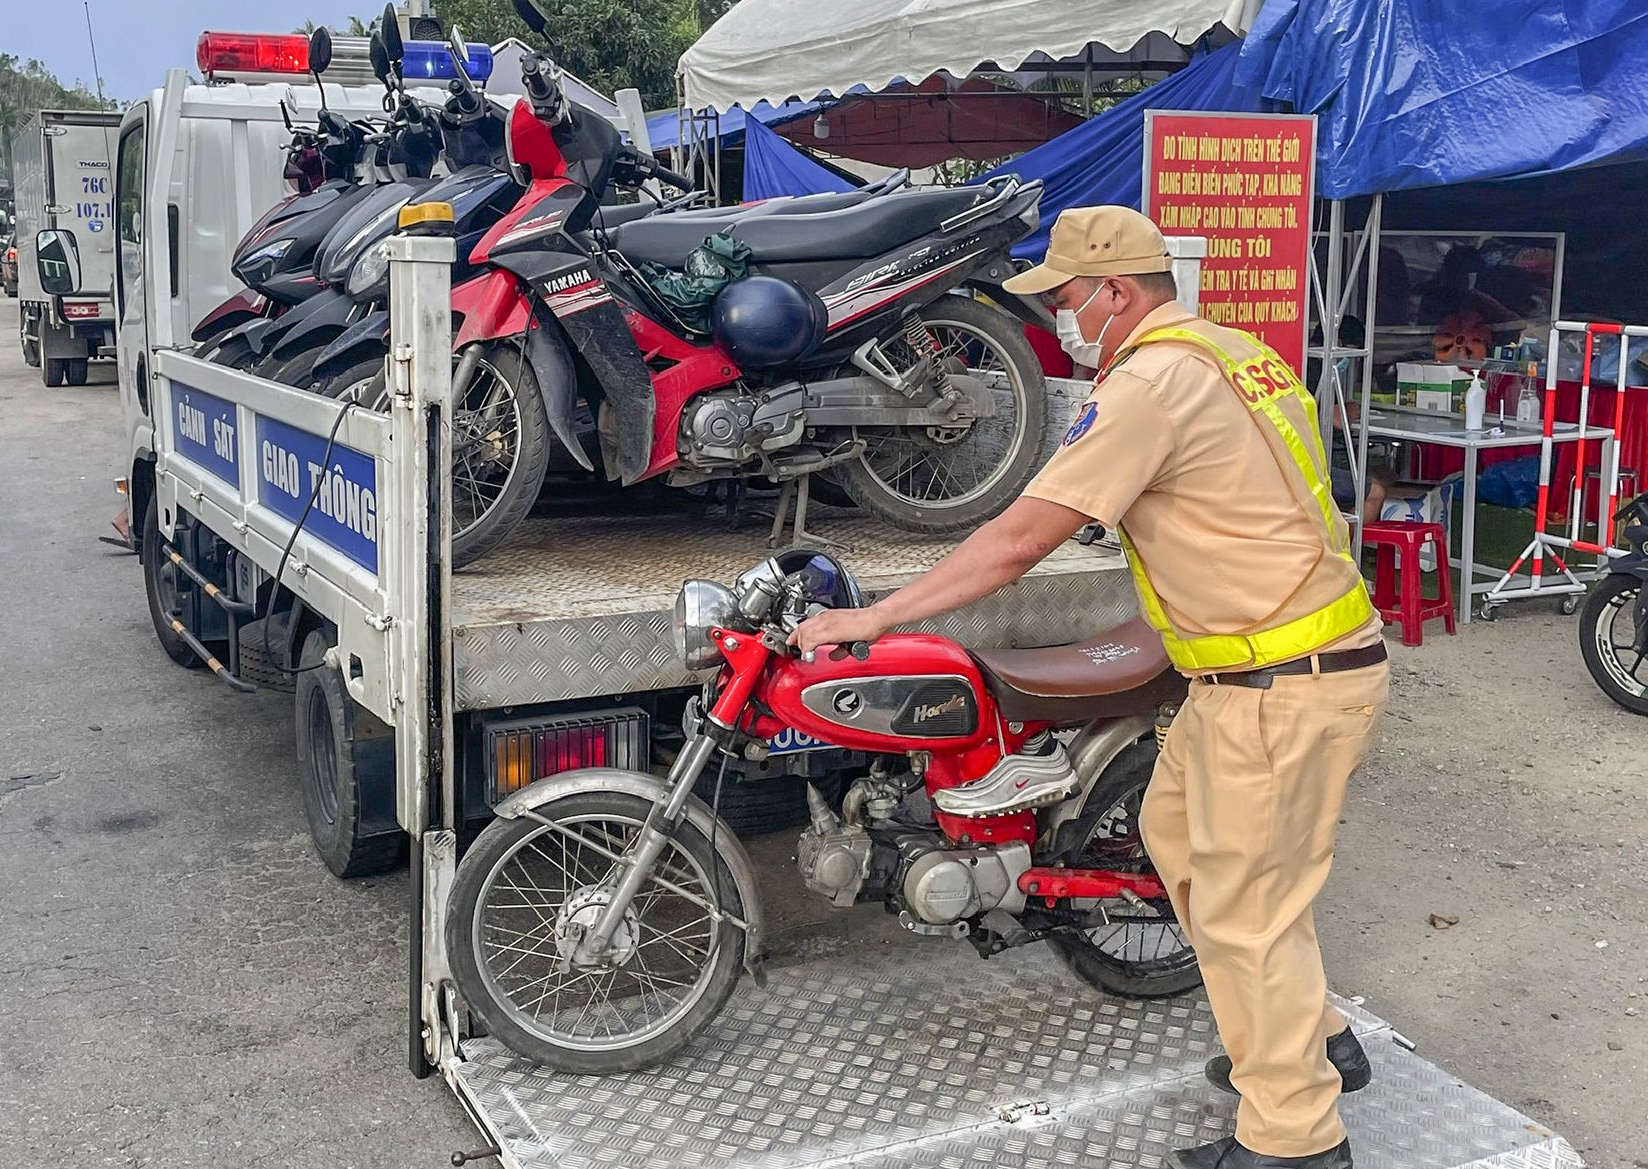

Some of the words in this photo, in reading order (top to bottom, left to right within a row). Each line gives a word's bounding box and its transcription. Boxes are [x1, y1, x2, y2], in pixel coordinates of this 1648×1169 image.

[1164, 135, 1176, 160] DO
[1177, 131, 1198, 160] TÌNH
[1199, 131, 1220, 161] HÌNH
[1221, 137, 1242, 167] DỊCH
[1243, 133, 1265, 162] TRÊN
[1266, 130, 1283, 162] THẾ
[1282, 132, 1300, 162] GIỚI
[82, 177, 108, 193] 76C
[1202, 165, 1221, 196] BIẾN
[1222, 167, 1243, 196] PHỨC
[1262, 164, 1279, 196] KHẢ
[76, 202, 111, 218] 107.1
[1160, 201, 1178, 228] XÂM
[1180, 202, 1202, 234] NHẬP
[1203, 206, 1219, 229] CAO
[1221, 202, 1236, 229] VÀO
[1256, 202, 1283, 229] CHÚNG
[1208, 234, 1242, 258] ÚNG
[1246, 234, 1272, 258] TÔI
[543, 269, 592, 294] YAMAHA
[1216, 269, 1230, 291] TRA
[1232, 269, 1238, 291] Y
[1238, 262, 1249, 291] TẾ
[1249, 265, 1260, 291] VÀ
[1275, 264, 1297, 295] NHẬN
[1238, 293, 1253, 323] CỦA
[1254, 297, 1270, 325] QUÝ
[178, 394, 207, 447] CẢNH
[213, 413, 235, 463] SÁT
[262, 440, 300, 499] GIAO
[307, 461, 377, 543] THÔNG
